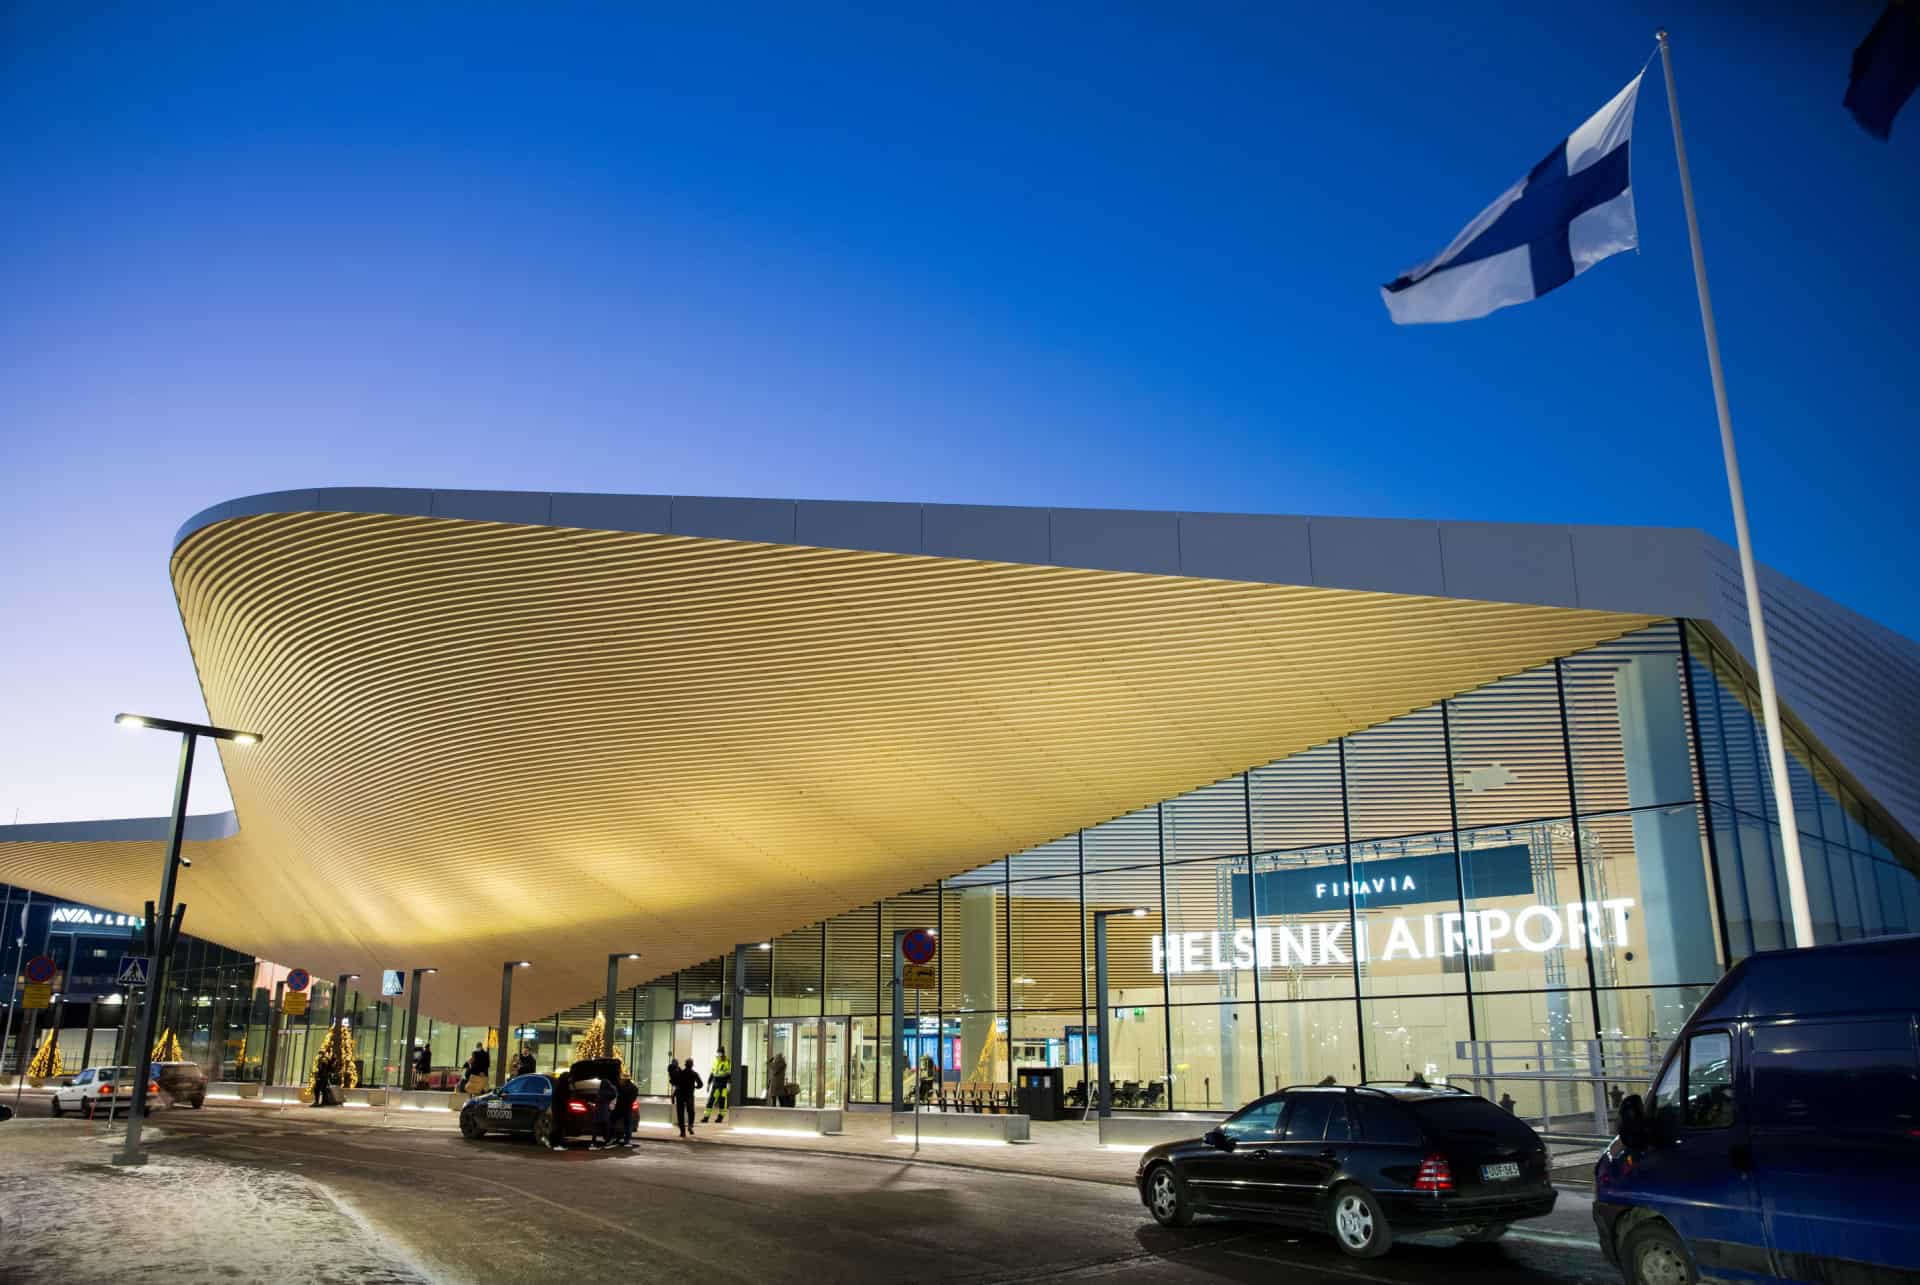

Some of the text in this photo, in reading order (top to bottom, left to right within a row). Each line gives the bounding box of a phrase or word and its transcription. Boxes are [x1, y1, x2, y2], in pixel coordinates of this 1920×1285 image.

[1315, 875, 1416, 898] FINAVIA
[1152, 899, 1635, 974] HELSINKI AIRPORT
